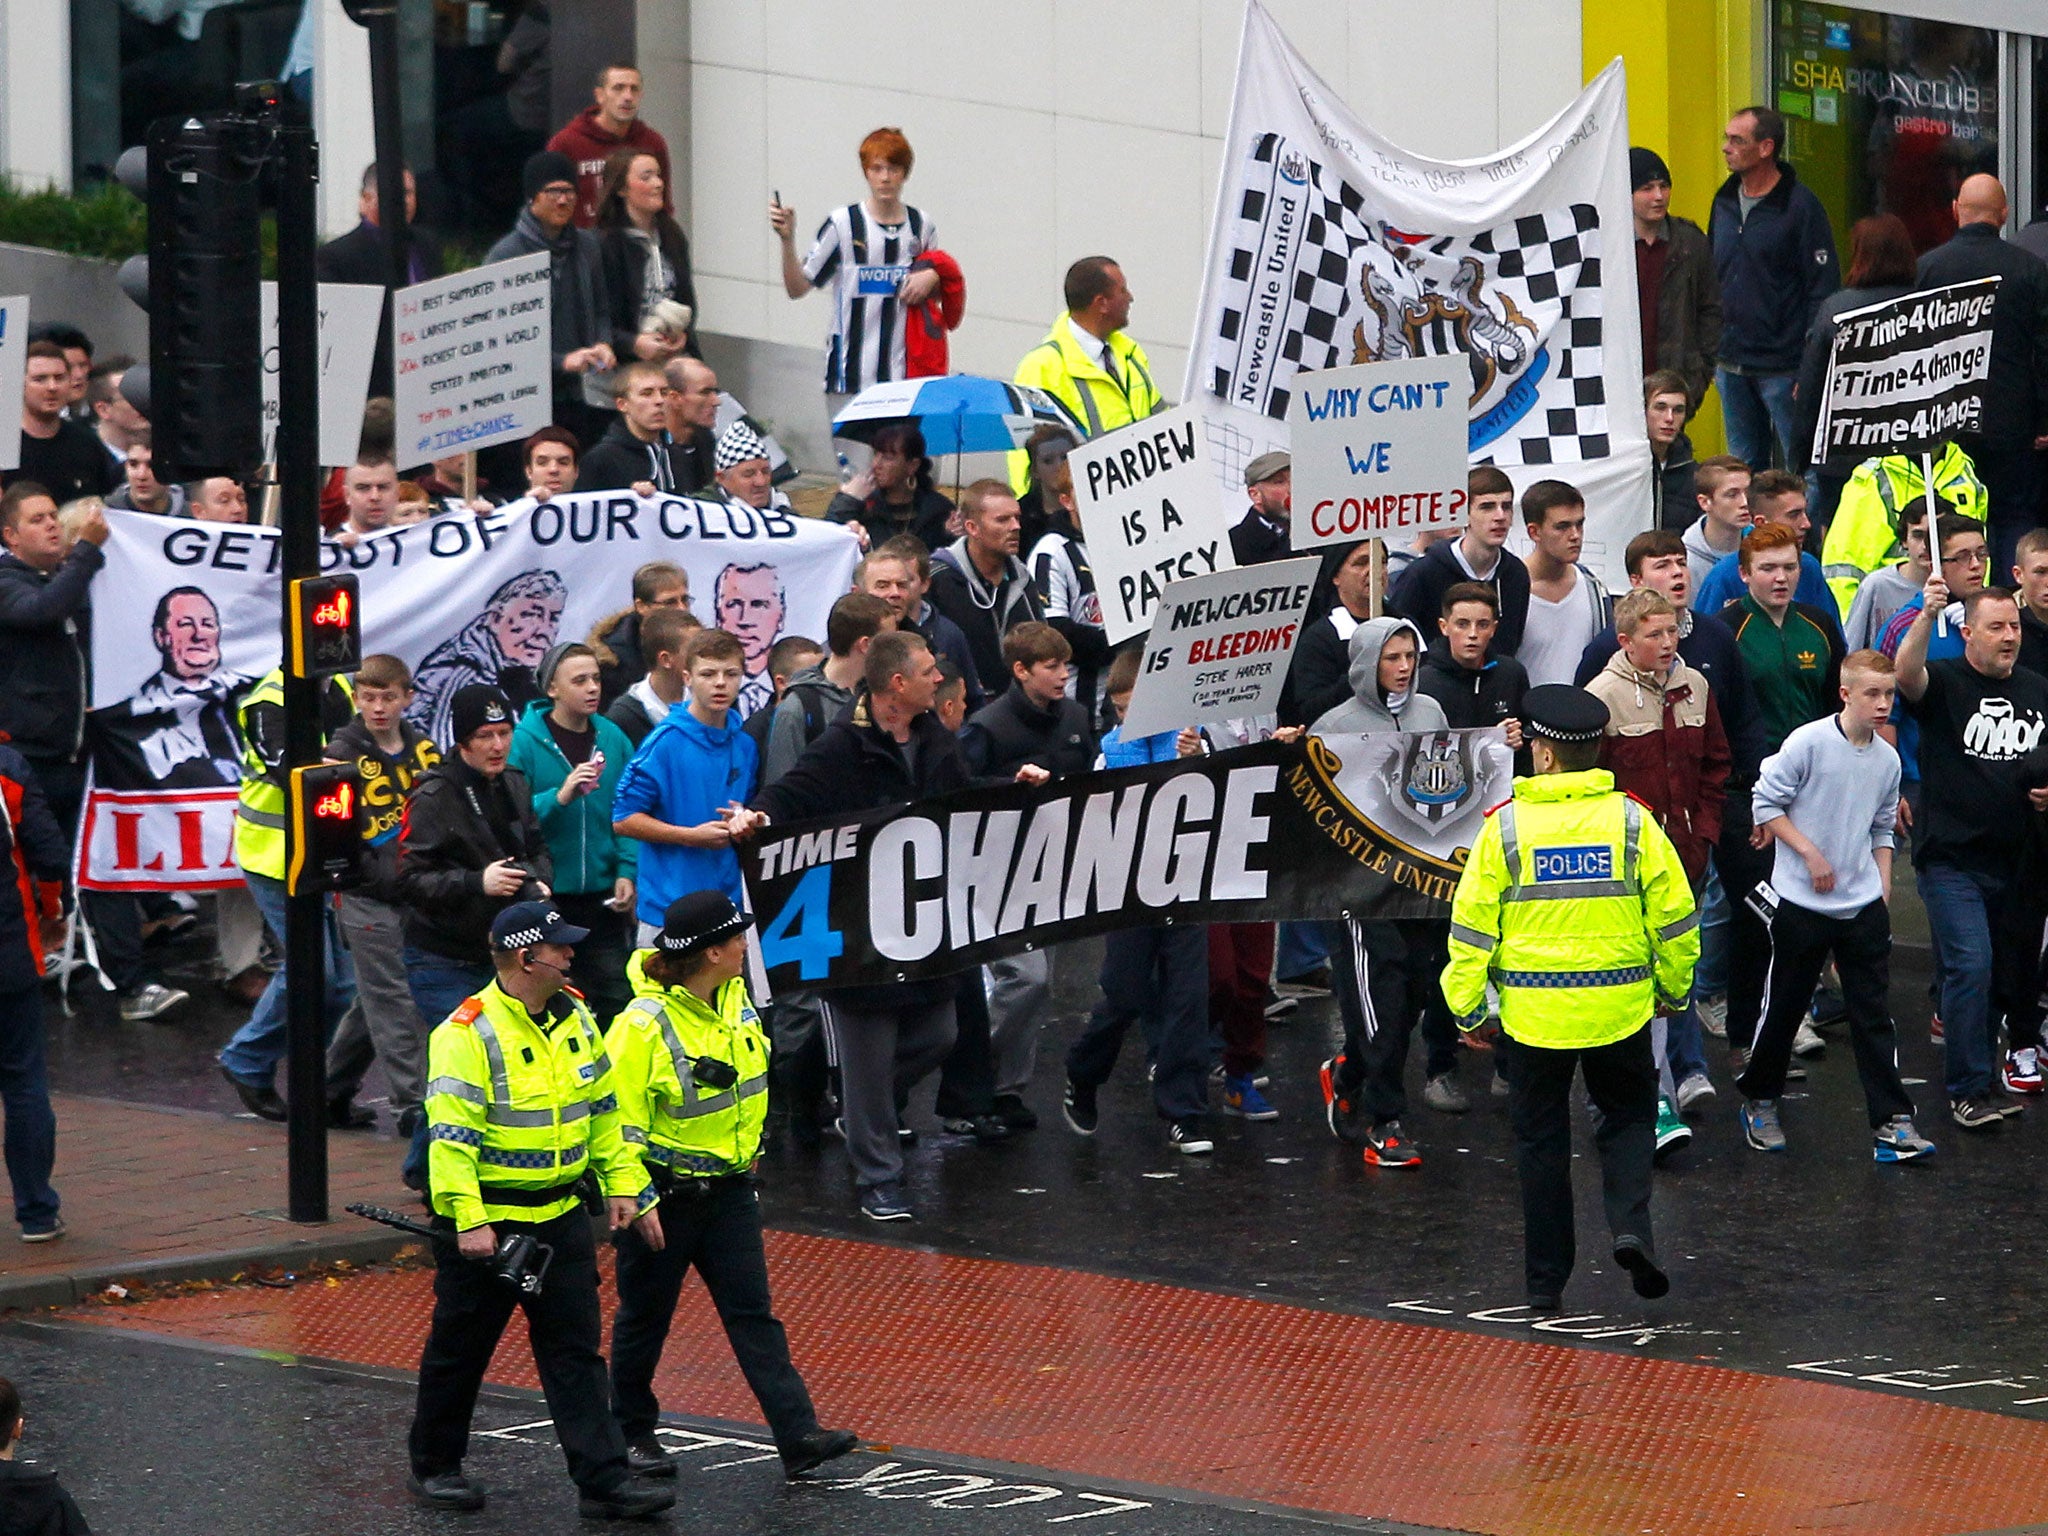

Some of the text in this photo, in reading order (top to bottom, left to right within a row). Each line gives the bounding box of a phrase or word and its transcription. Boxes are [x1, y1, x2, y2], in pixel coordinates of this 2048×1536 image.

[1894, 115, 1979, 139] gastro bar
[422, 295, 444, 312] BEST
[448, 281, 496, 304] SUPPORTED
[503, 277, 514, 289] IN
[1240, 198, 1297, 404] Newcastle United
[461, 341, 484, 356] CLUB
[506, 325, 541, 344] WORLD
[1835, 293, 1996, 352] #Time4Change
[1304, 381, 1450, 422] WHY CAN'T
[1087, 421, 1195, 501] PARDEW
[1345, 442, 1392, 475] WE
[163, 527, 282, 573] GET
[430, 514, 508, 557] OF
[530, 499, 639, 545] OUR
[660, 500, 797, 539] CLUB
[1122, 498, 1183, 546] IS A
[1311, 489, 1467, 538] COMPETE?
[1119, 541, 1218, 623] PATSY
[1146, 648, 1173, 674] IS
[1194, 662, 1273, 687] STEVE HARPER
[1285, 762, 1392, 875] NEWCASTLE
[759, 764, 1279, 961] TIME CHANGE
[1535, 851, 1611, 876] POLICE
[759, 865, 844, 981] 4
